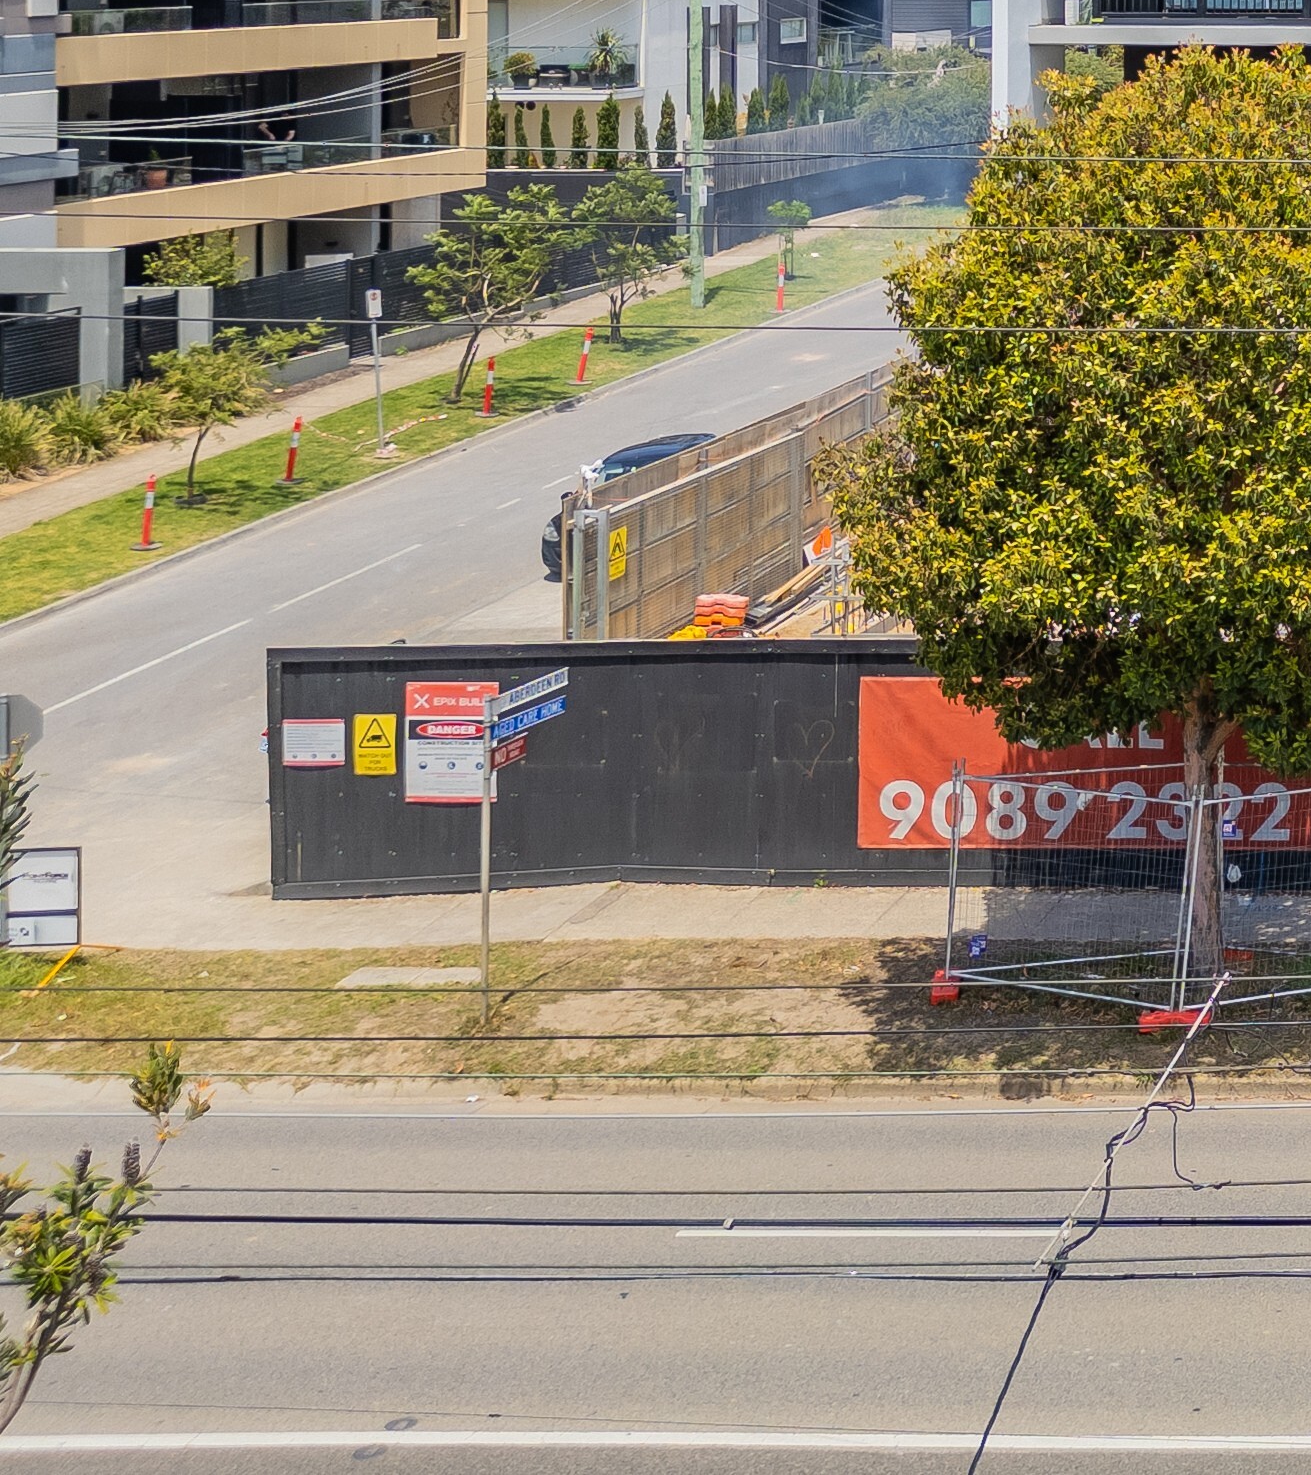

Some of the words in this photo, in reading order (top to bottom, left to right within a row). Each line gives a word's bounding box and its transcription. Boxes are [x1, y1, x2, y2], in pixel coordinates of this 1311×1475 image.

[510, 677, 552, 702] ABERDEEN
[554, 671, 565, 686] RD
[433, 697, 457, 706] EPIX
[459, 697, 485, 706] BUIL
[427, 725, 477, 735] DANGER
[493, 719, 515, 738] AGED
[518, 709, 539, 728] CARE
[541, 699, 563, 719] HOME
[494, 746, 507, 765] NO
[879, 779, 1082, 840] 9089
[1105, 780, 1292, 841] 2322
